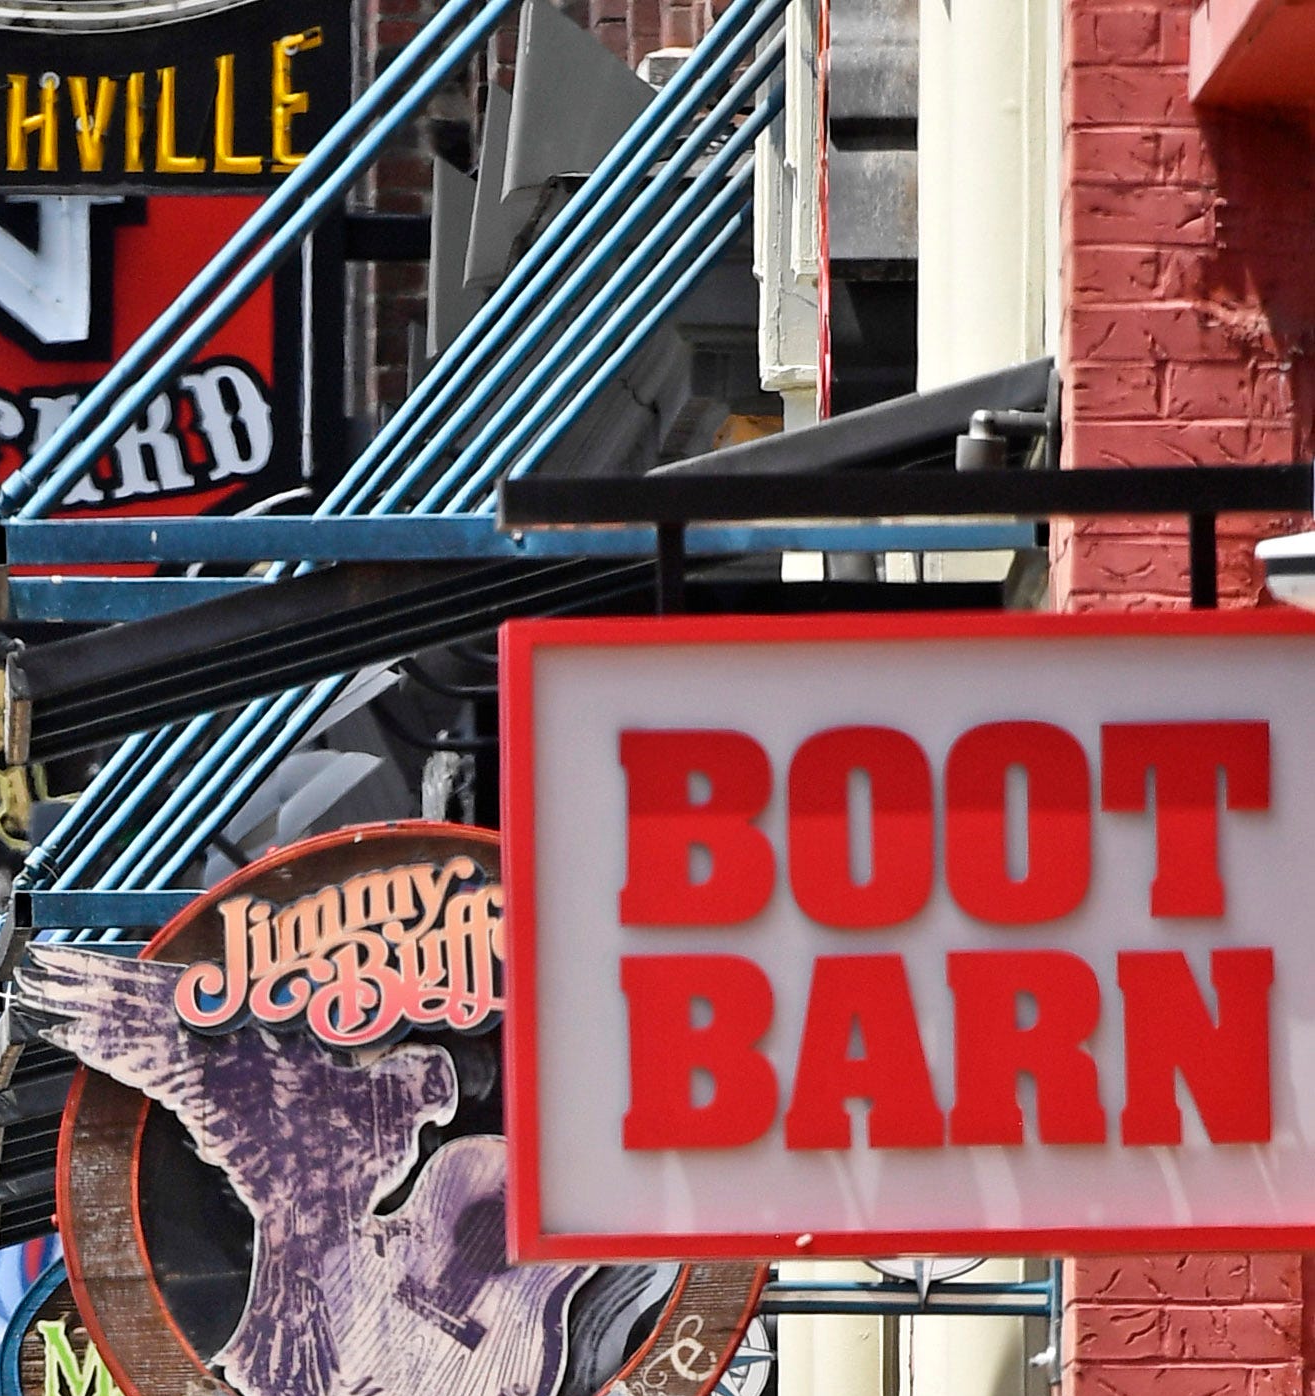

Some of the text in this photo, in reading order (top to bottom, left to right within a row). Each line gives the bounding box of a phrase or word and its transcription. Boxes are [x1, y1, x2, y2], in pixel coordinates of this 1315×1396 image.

[619, 719, 1271, 930] BOOT
[175, 855, 475, 1028] Jimmy
[619, 947, 1274, 1151] BARN
